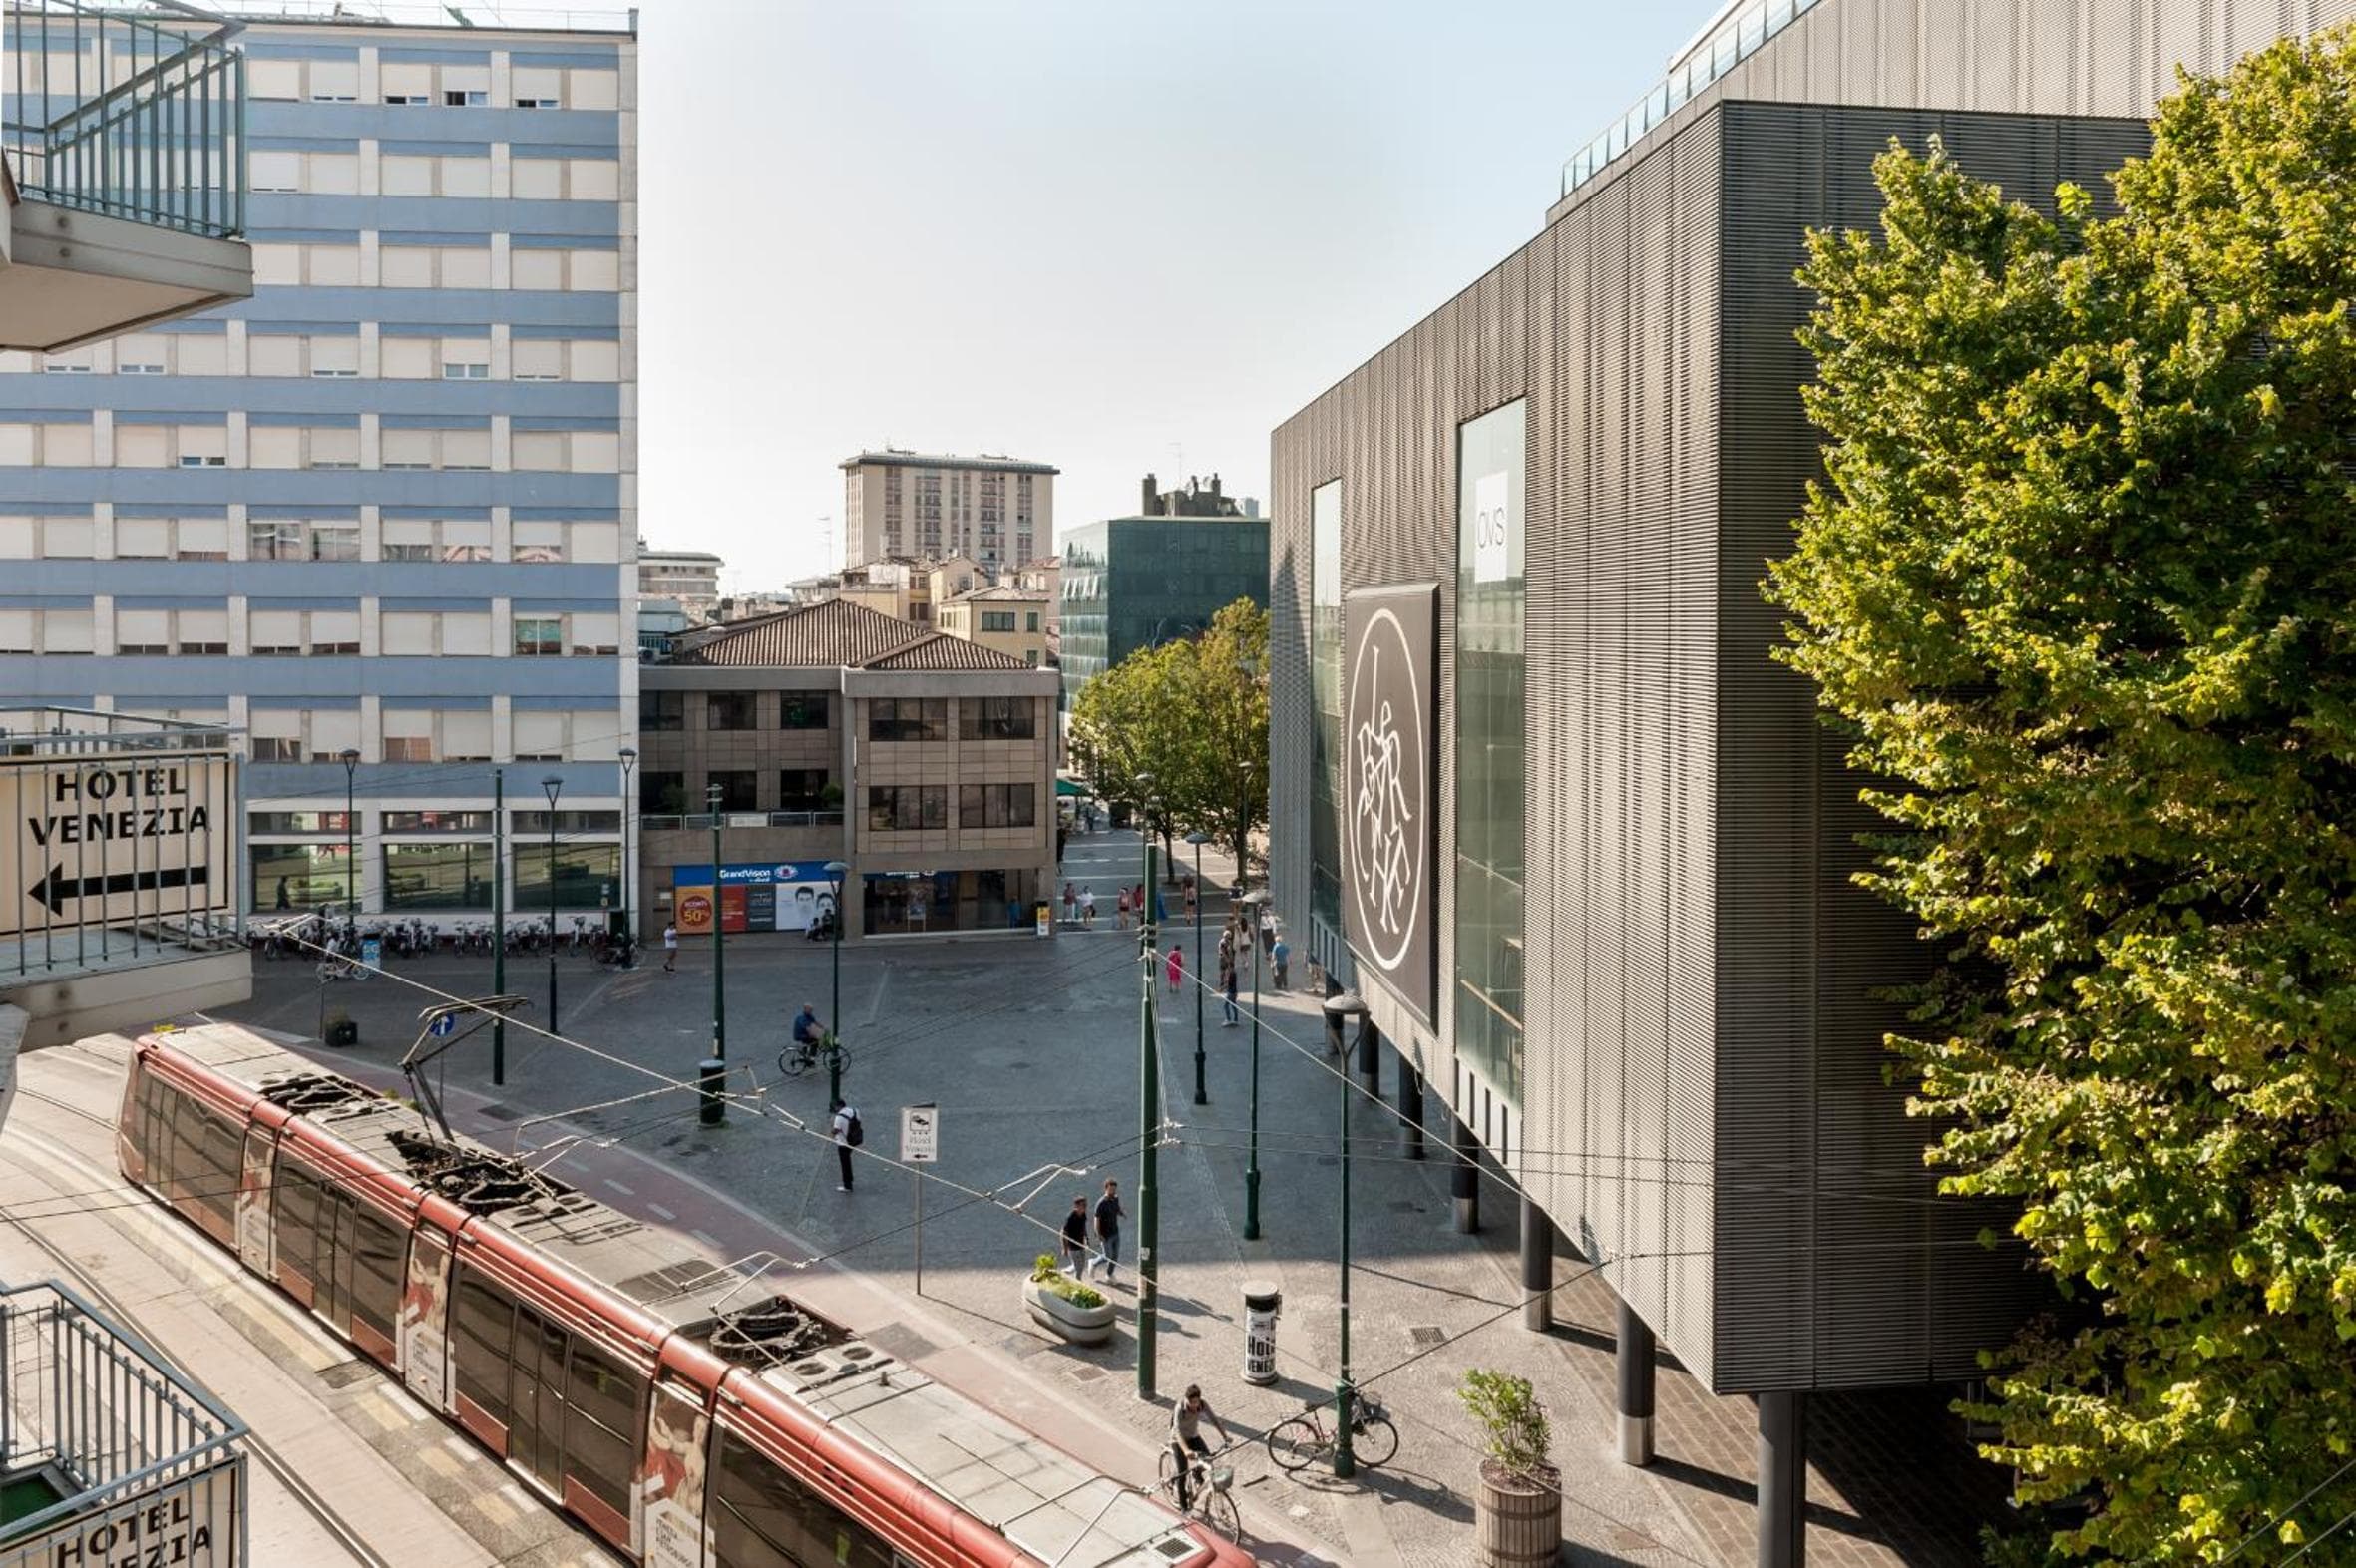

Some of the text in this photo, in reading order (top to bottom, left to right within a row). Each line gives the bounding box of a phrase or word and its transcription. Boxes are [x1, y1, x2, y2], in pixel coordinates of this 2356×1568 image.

[56, 768, 188, 802] HOTEL
[28, 806, 208, 846] VENEZIA
[719, 867, 771, 879] GrandVision
[57, 1497, 190, 1568] HOTEL
